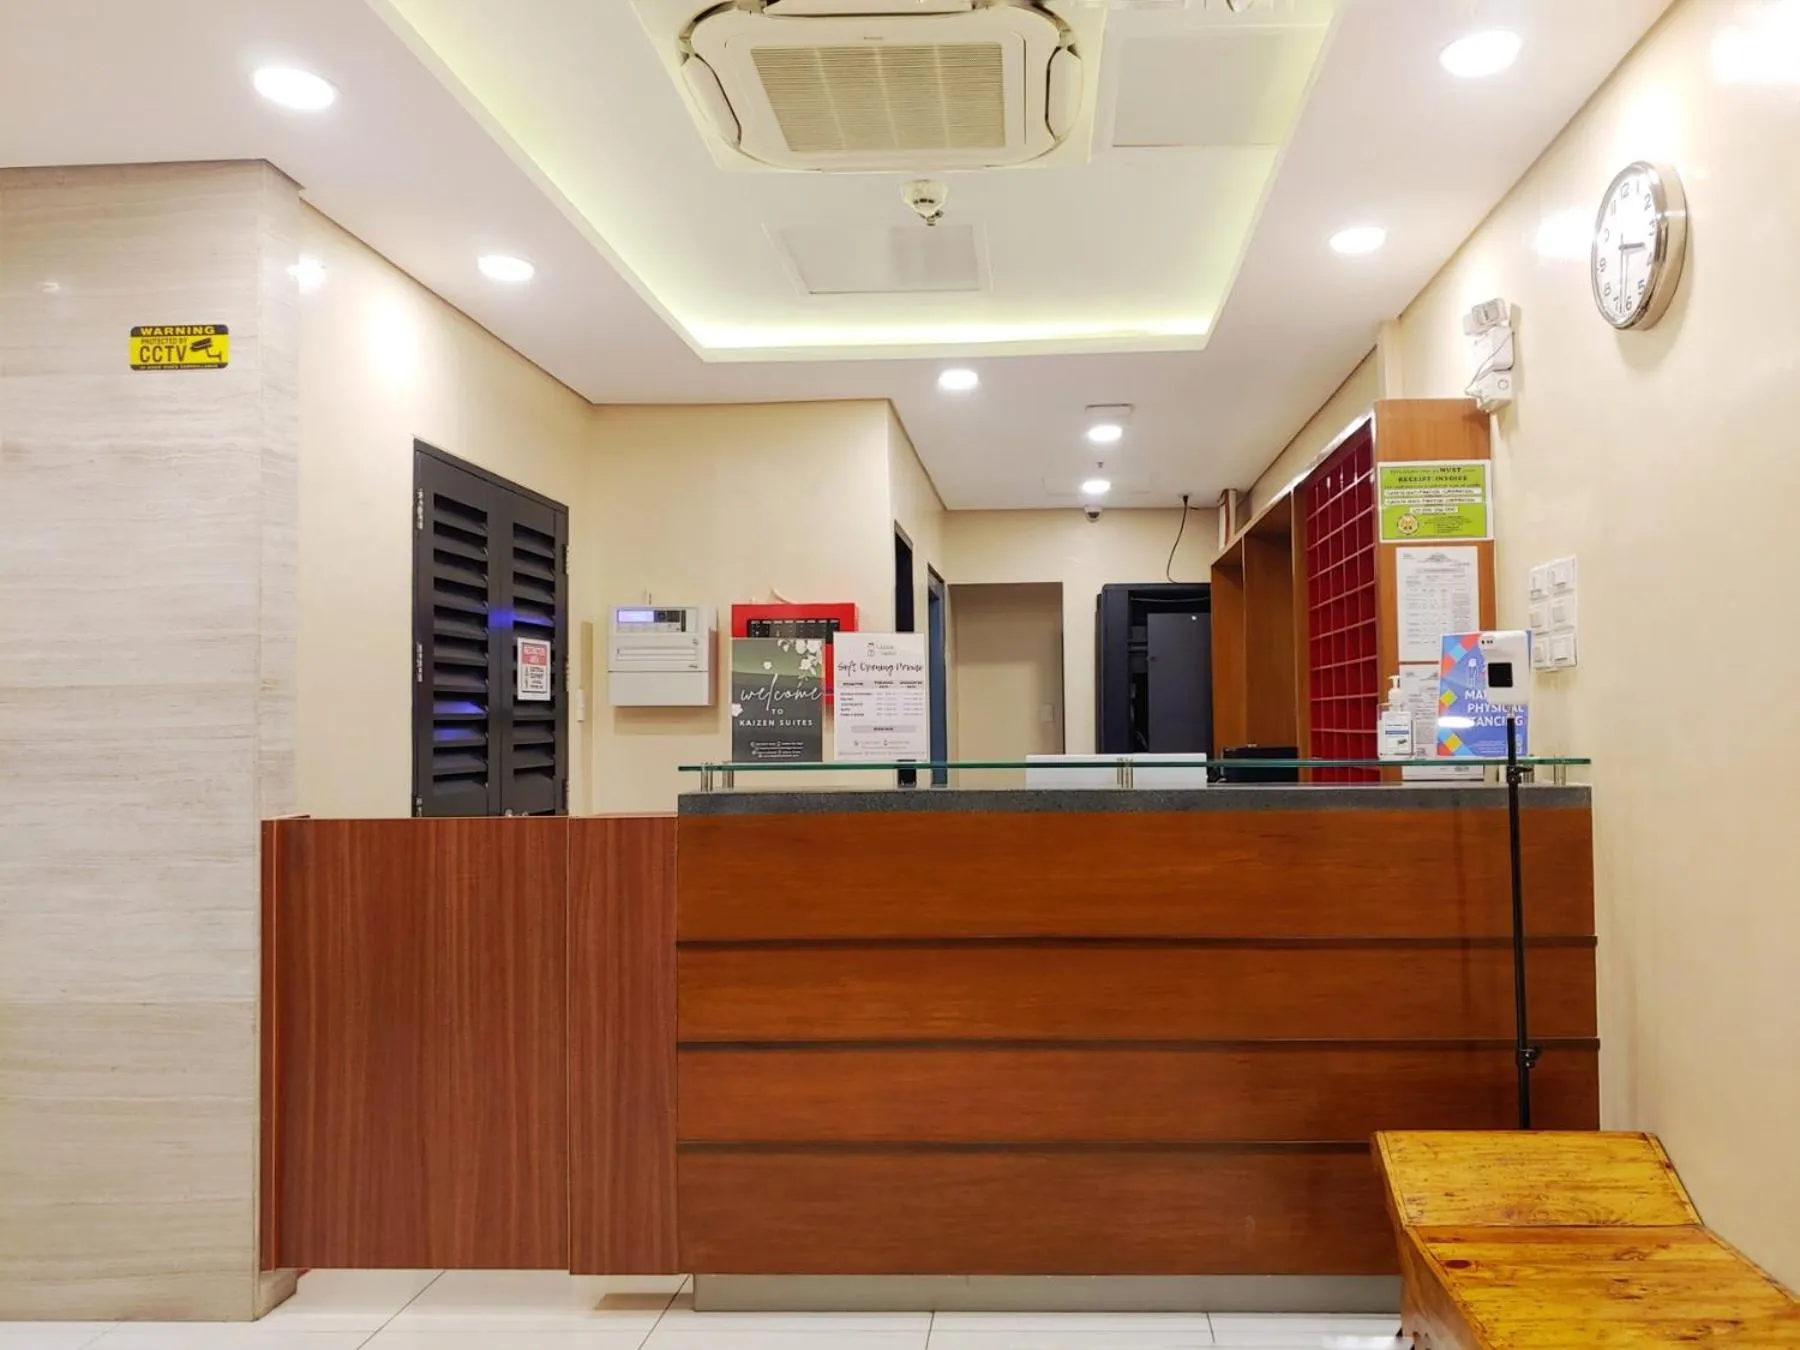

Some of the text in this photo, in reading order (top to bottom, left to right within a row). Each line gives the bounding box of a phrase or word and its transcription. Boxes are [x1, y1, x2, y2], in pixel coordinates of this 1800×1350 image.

[1620, 182, 1630, 199] 12
[1644, 193, 1652, 211] 2
[1599, 257, 1607, 272] 9
[1603, 282, 1611, 297] 8
[1637, 279, 1645, 295] 5
[1625, 296, 1633, 311] 6
[140, 326, 216, 336] WARNING
[140, 345, 187, 362] CCTV
[740, 673, 824, 711] welcome
[739, 719, 814, 727] KAIZEN SUITES
